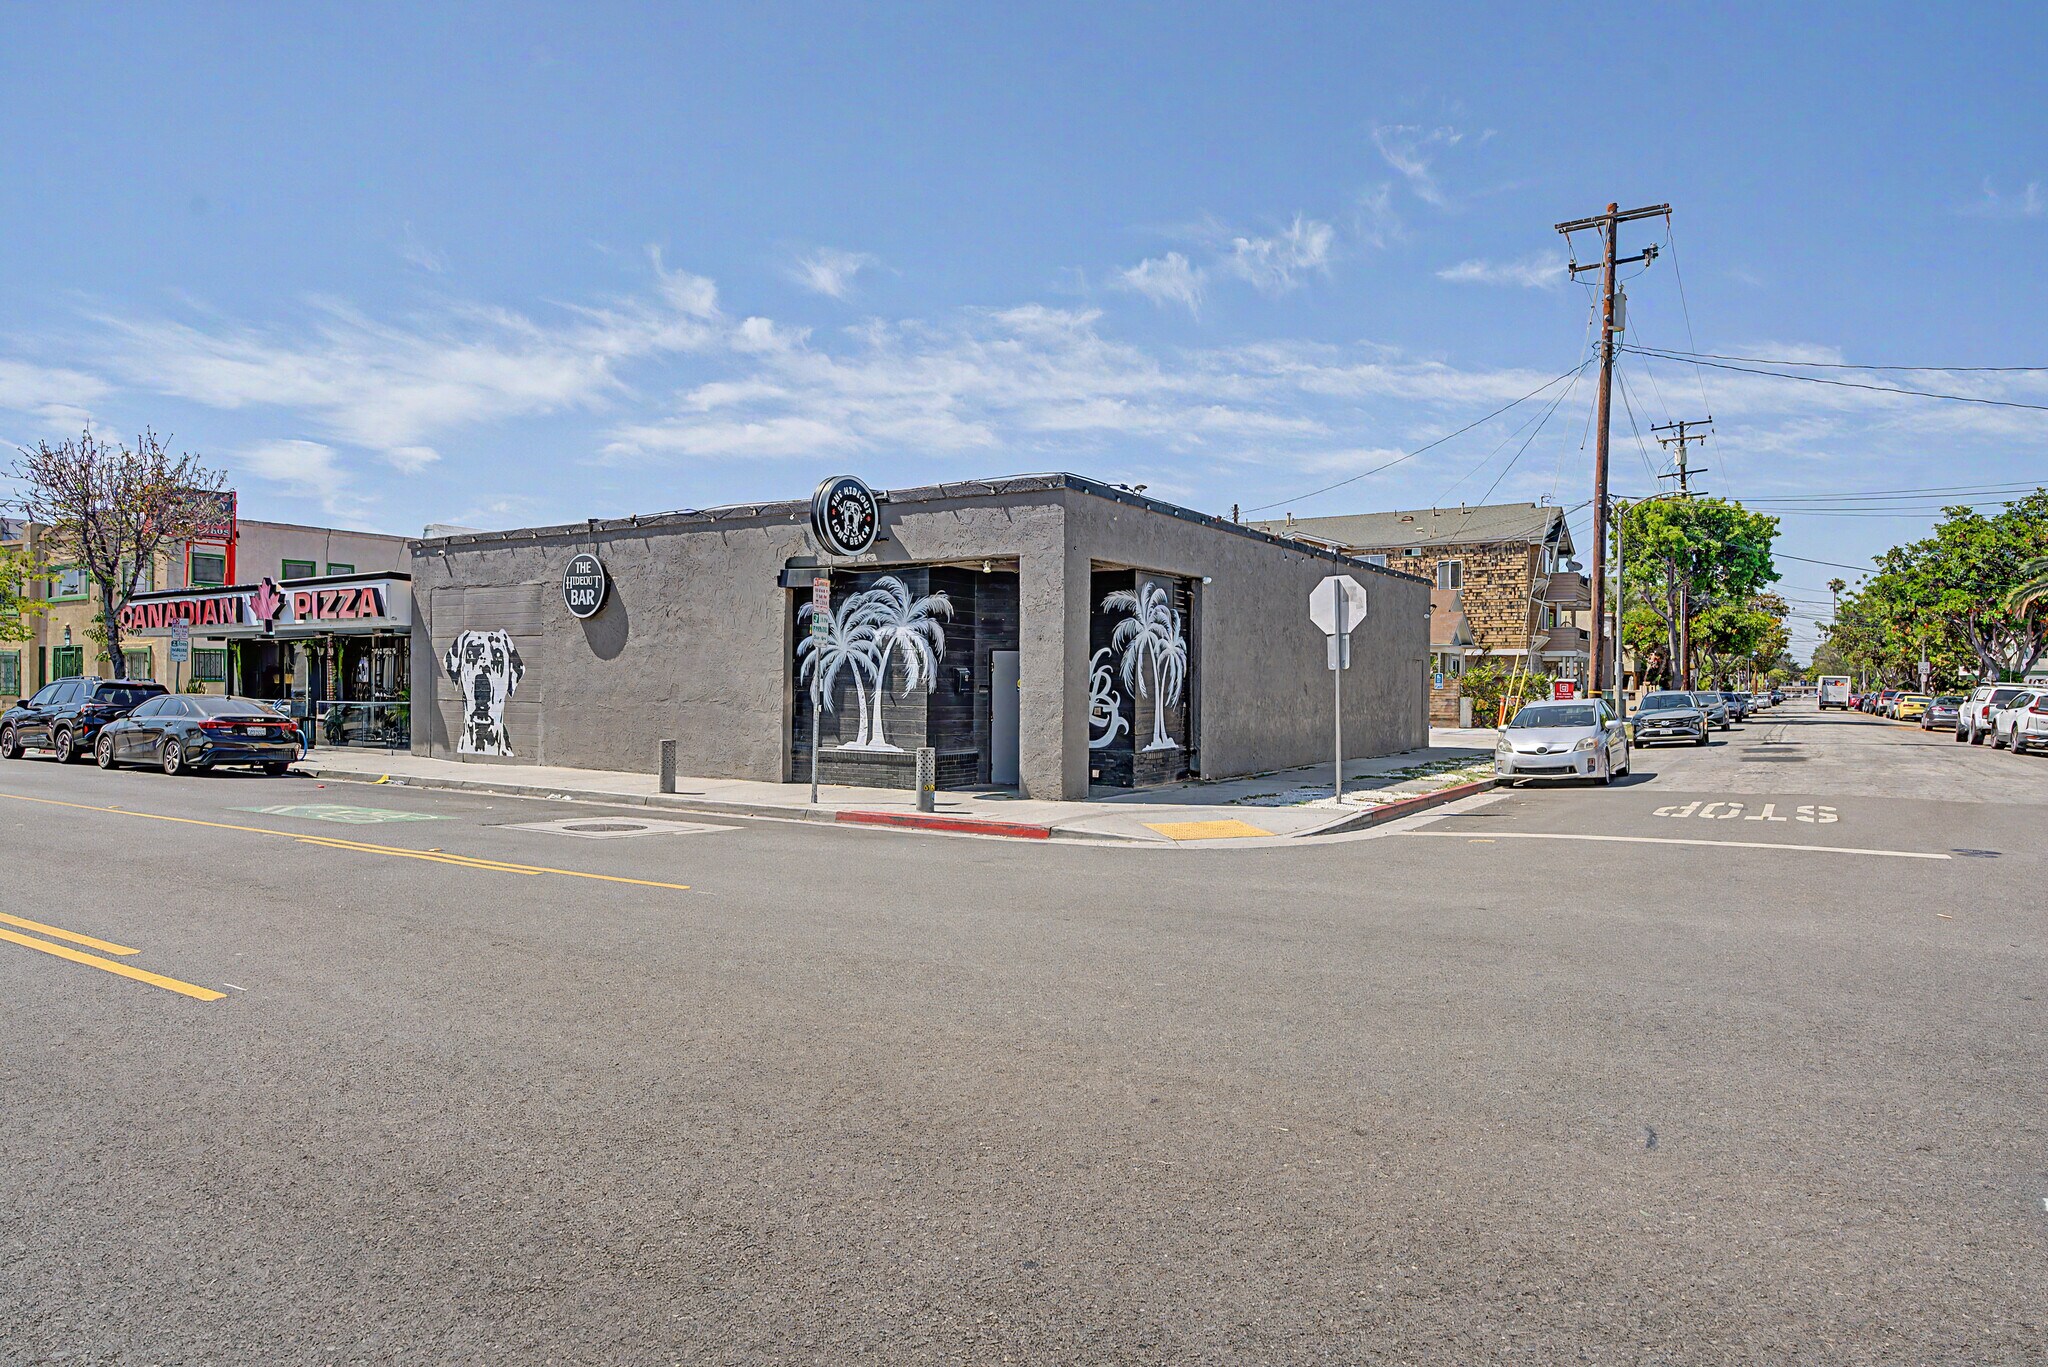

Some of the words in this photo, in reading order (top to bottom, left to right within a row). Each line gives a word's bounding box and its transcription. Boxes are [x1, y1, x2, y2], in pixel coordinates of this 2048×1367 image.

[831, 490, 843, 507] THE
[843, 486, 872, 514] HIDEOUT
[832, 519, 848, 543] LONG
[849, 525, 871, 546] BEACH
[575, 561, 592, 574] THE
[566, 575, 601, 590] HIDEOUT
[120, 597, 238, 629] CANADIAN
[294, 587, 382, 620] PIZZA
[570, 589, 595, 606] BAR
[1652, 801, 1839, 823] STOP
